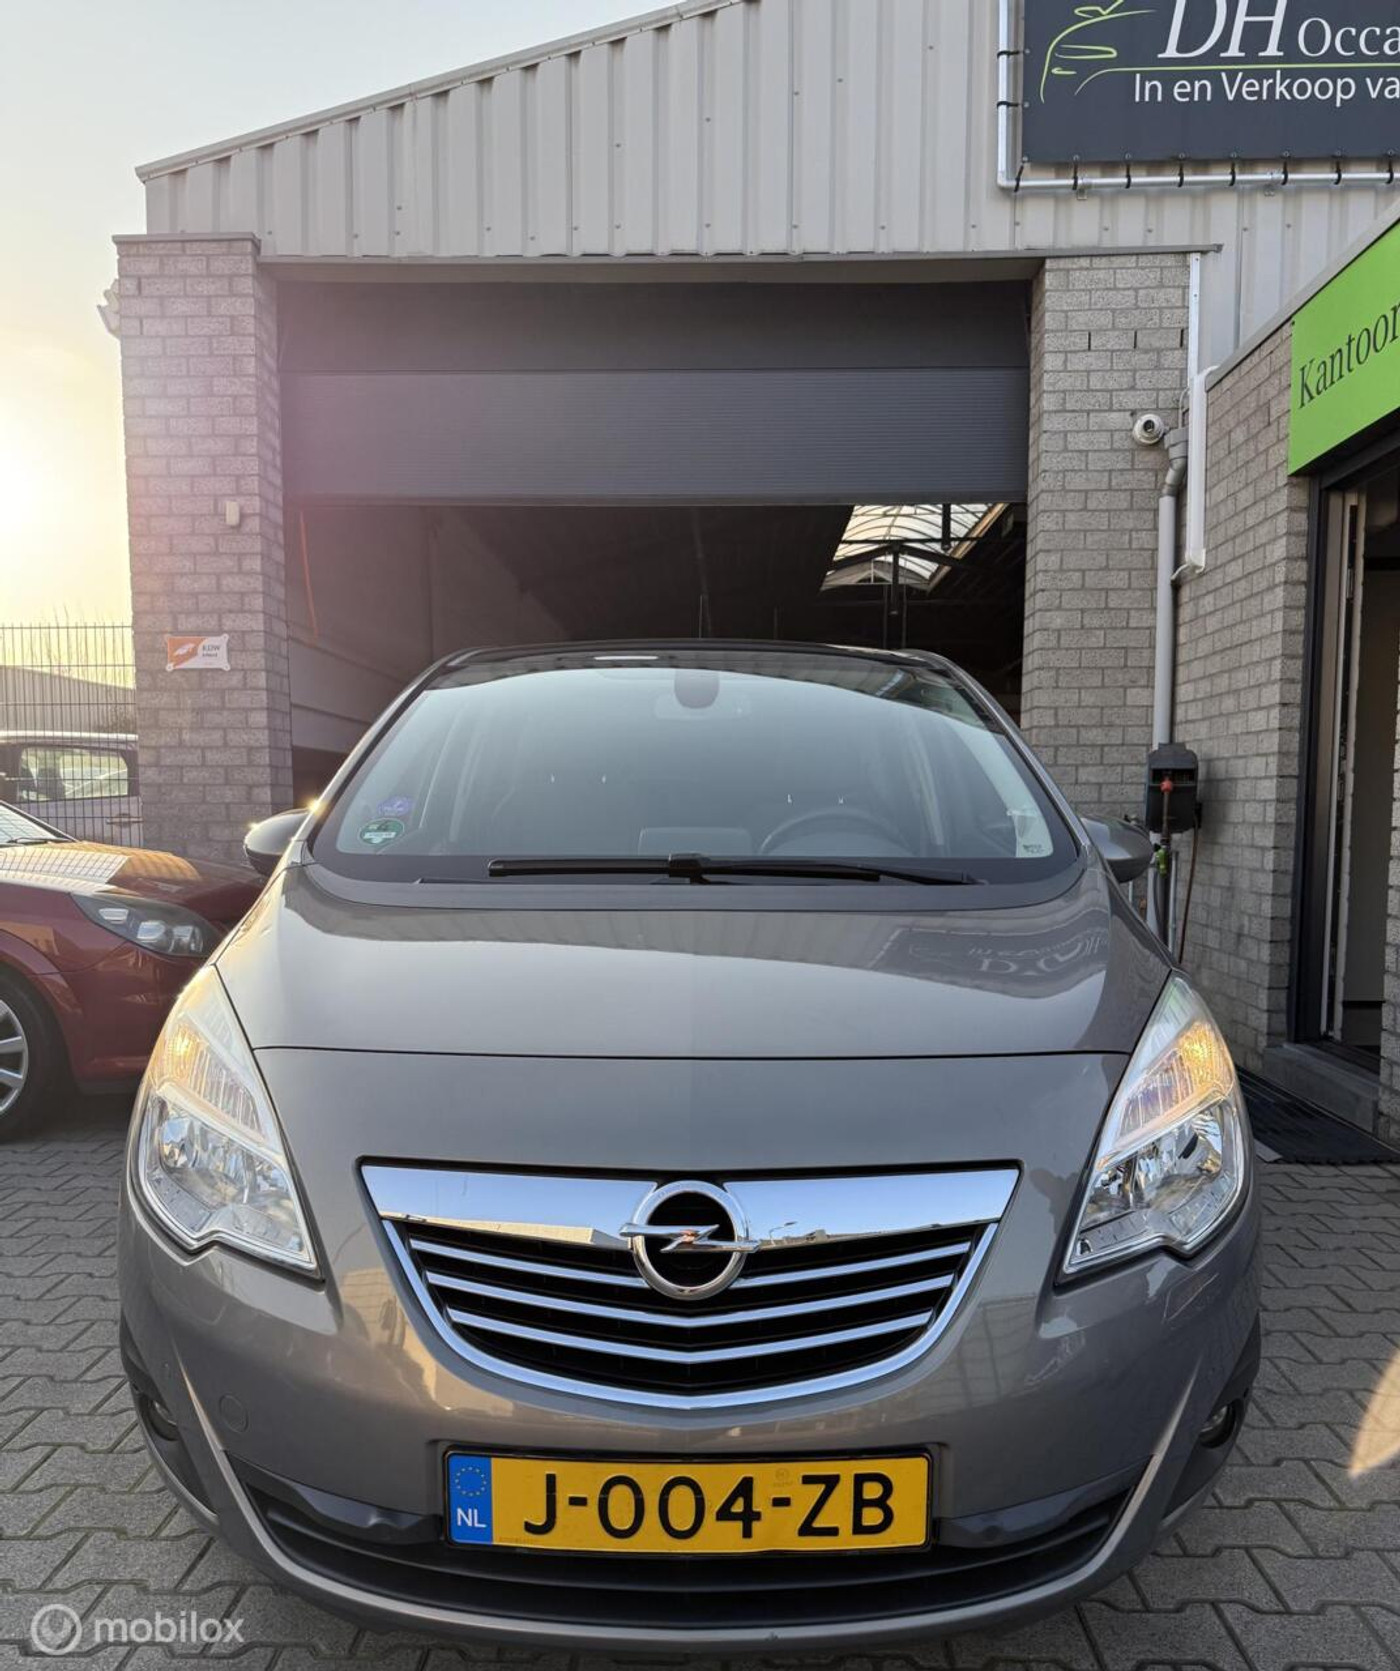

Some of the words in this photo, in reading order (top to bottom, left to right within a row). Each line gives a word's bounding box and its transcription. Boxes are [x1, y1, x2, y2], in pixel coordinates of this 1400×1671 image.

[1157, 0, 1288, 58] DH
[1297, 17, 1400, 57] Occa
[1134, 73, 1162, 102] In
[1173, 78, 1212, 102] en
[1220, 70, 1356, 107] Verkoop
[1365, 77, 1400, 100] va
[456, 1508, 487, 1529] NL
[523, 1472, 895, 1540] J-004-ZB
